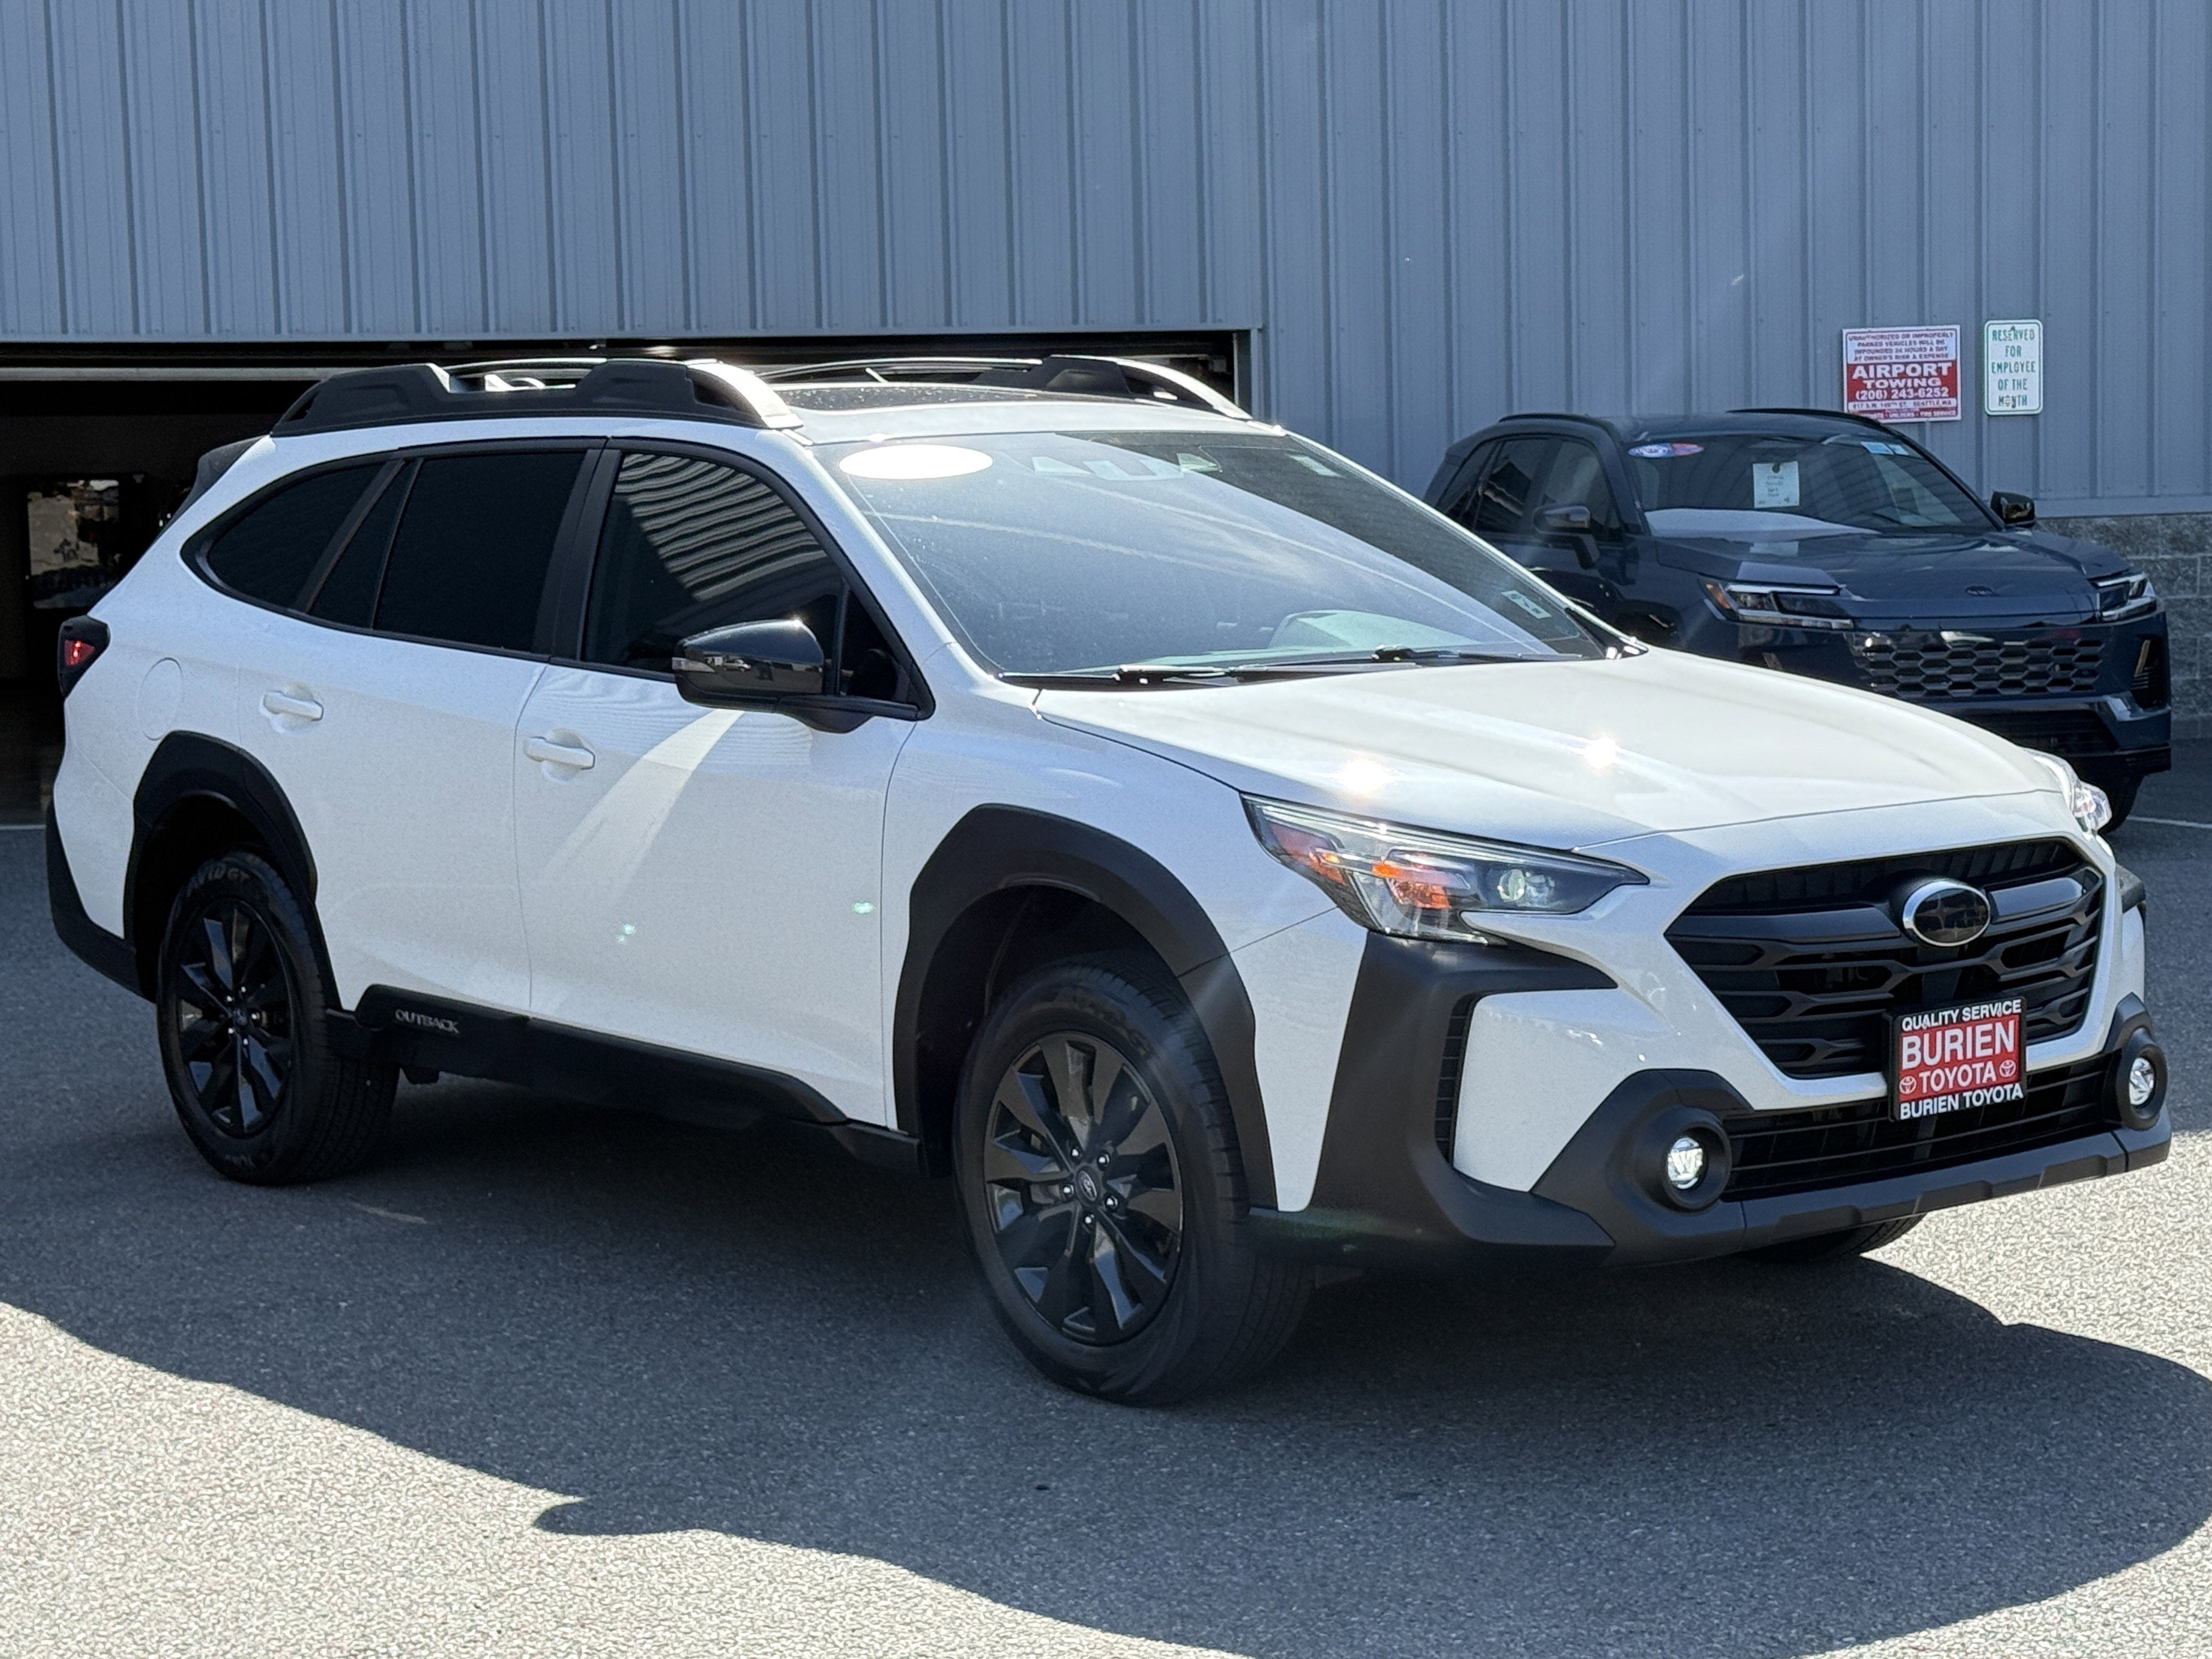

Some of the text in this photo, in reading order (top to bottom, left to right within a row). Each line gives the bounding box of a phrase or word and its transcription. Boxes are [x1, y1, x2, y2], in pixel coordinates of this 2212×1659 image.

[1991, 328, 2035, 342] RESERVED
[2005, 345, 2022, 357] FOR
[1852, 362, 1953, 380] AIRPORT
[1991, 360, 2036, 374] EMPLOYEE
[1863, 377, 1942, 389] TOWING
[1997, 378, 2028, 391] OF THE
[1855, 390, 1888, 400] (206)
[1998, 394, 2028, 407] MONTH
[395, 1008, 459, 1034] OUTBACK
[1901, 999, 2022, 1032] QUALITY SERVICE
[1901, 1019, 2015, 1070] BURIEN
[1918, 1060, 1997, 1094] TOYOTA
[1900, 1082, 2024, 1120] BURIEN TOYOTA
